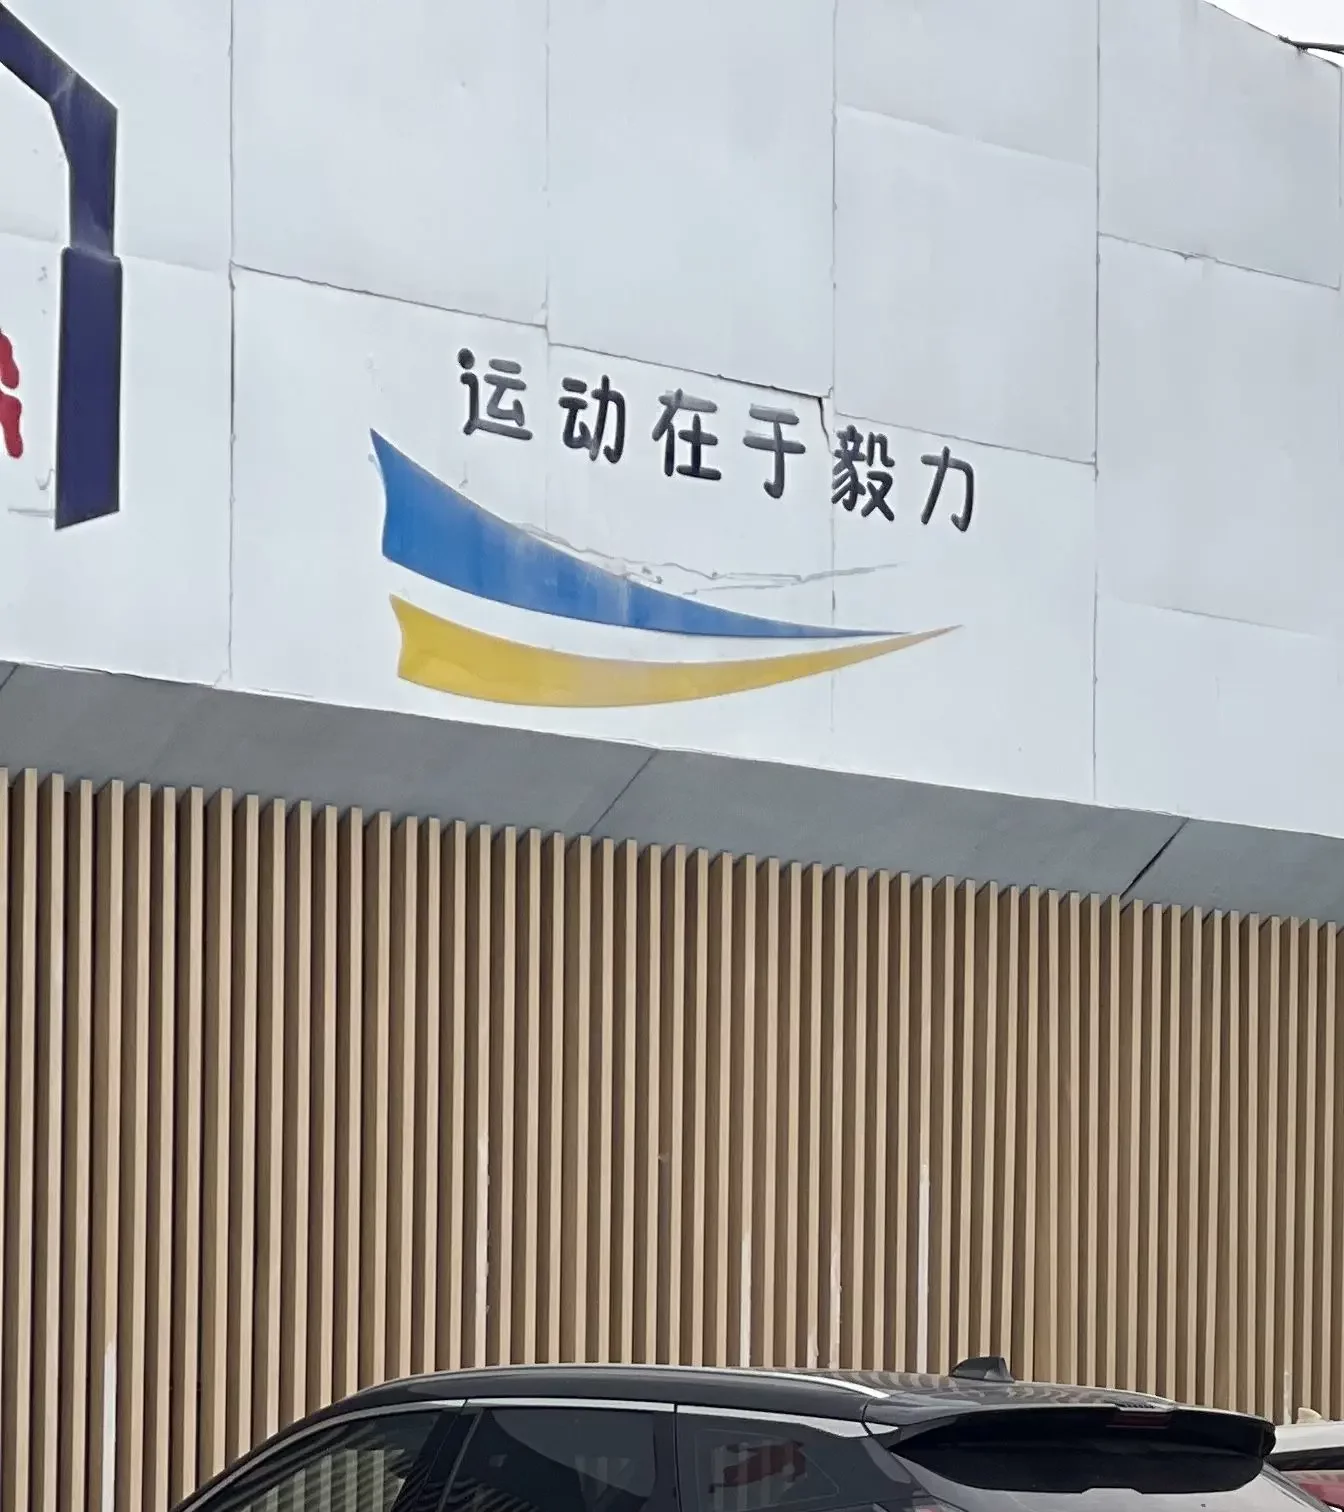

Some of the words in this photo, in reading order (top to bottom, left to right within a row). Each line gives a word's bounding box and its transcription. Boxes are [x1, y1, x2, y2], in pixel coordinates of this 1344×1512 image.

[457, 349, 975, 532] 运动在于毅力
